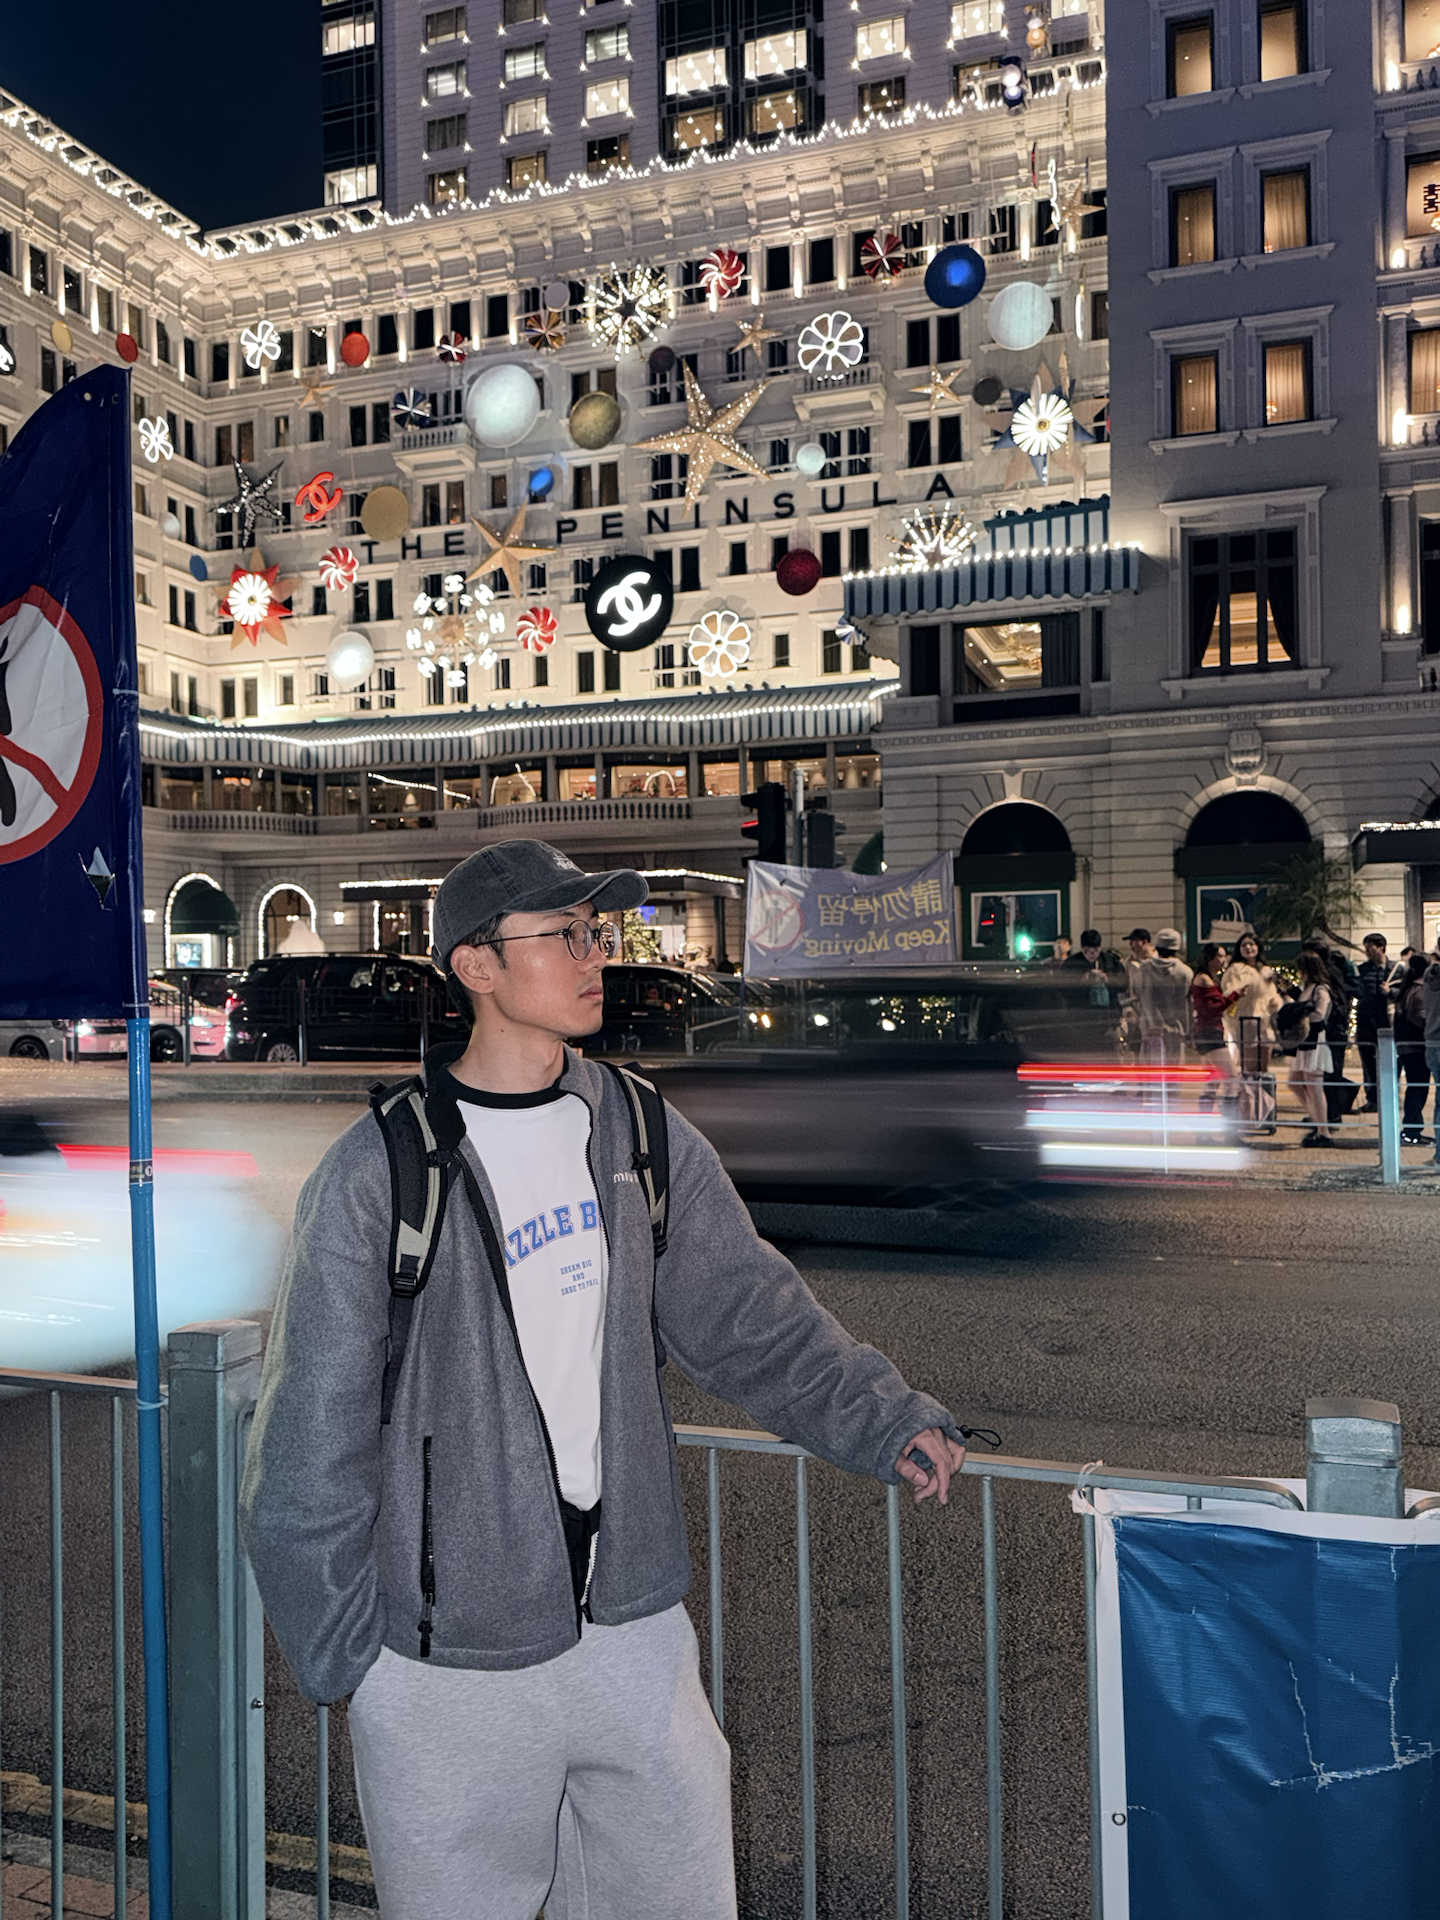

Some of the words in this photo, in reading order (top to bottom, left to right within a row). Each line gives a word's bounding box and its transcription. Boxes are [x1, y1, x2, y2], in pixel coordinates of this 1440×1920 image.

[360, 531, 465, 564] THE
[556, 473, 956, 544] PENINSULA
[577, 1199, 602, 1232] B
[560, 1262, 581, 1275] DREAM
[581, 1259, 592, 1269] BIG
[572, 1272, 585, 1282] AND
[560, 1285, 577, 1296] DARE
[577, 1282, 586, 1291] TO
[586, 1278, 599, 1288] FAIL
